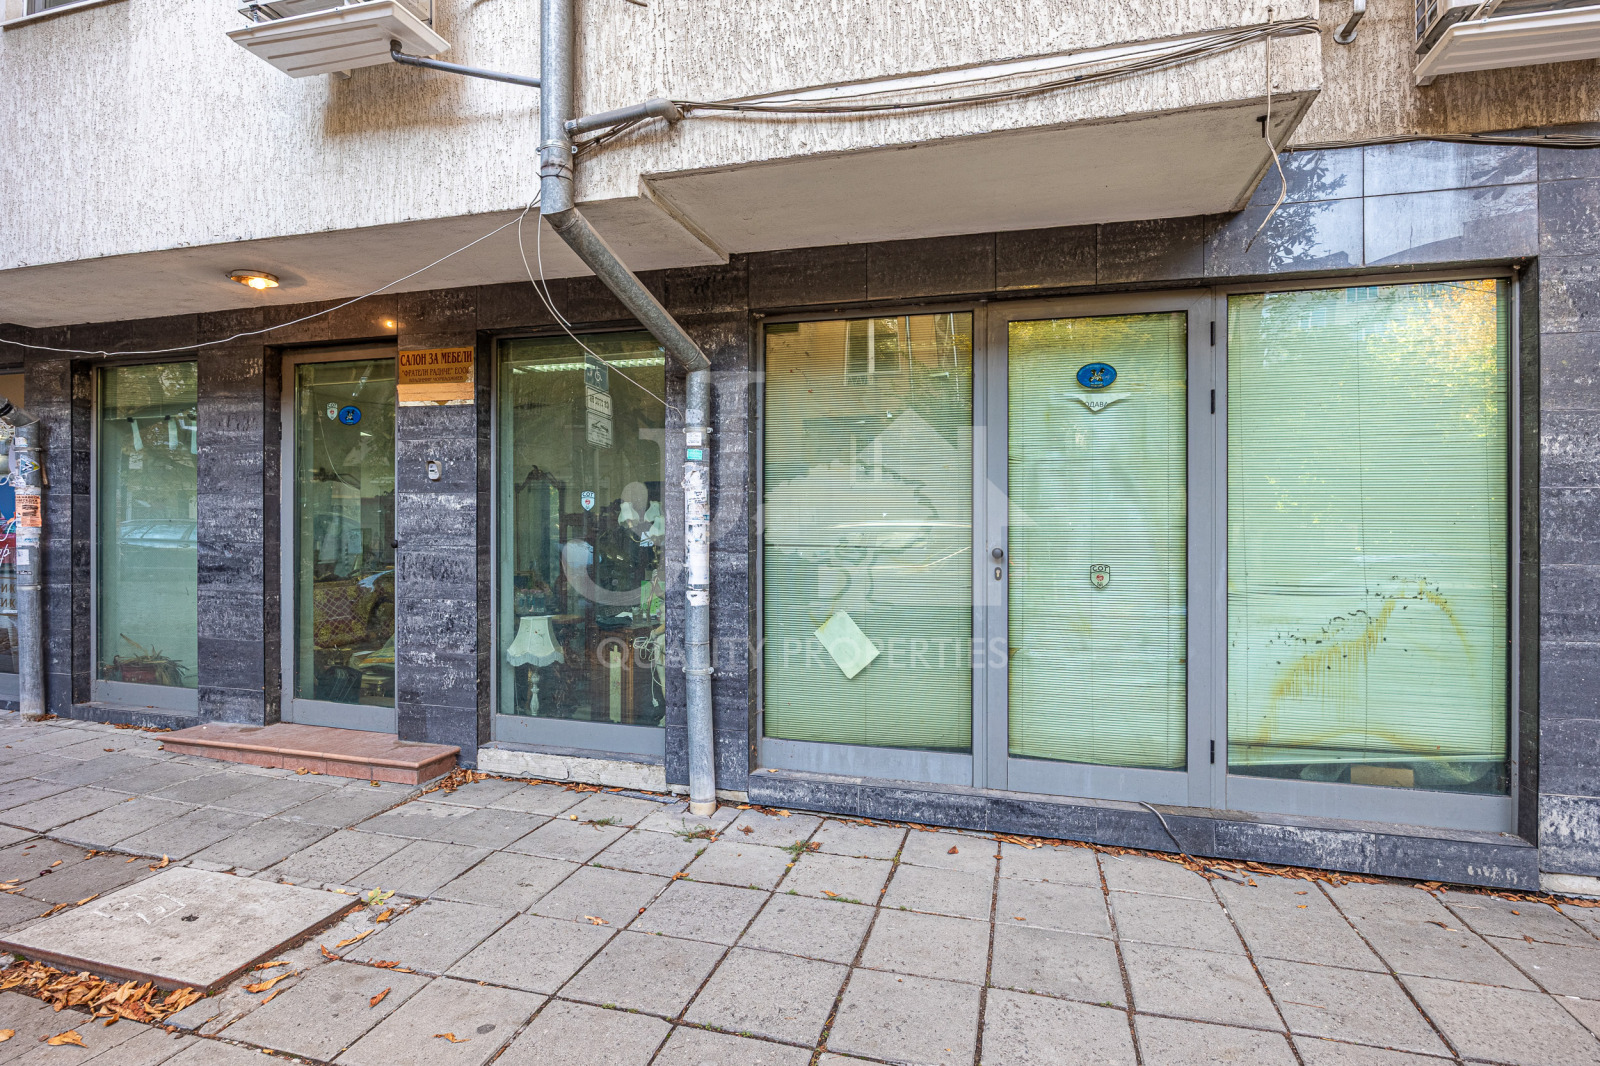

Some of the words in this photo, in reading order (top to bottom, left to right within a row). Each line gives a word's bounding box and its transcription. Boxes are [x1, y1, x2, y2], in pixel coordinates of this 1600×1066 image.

[400, 353, 427, 367] САЛОН
[428, 352, 439, 365] ЗА
[441, 350, 472, 364] МЕБЕЛИ
